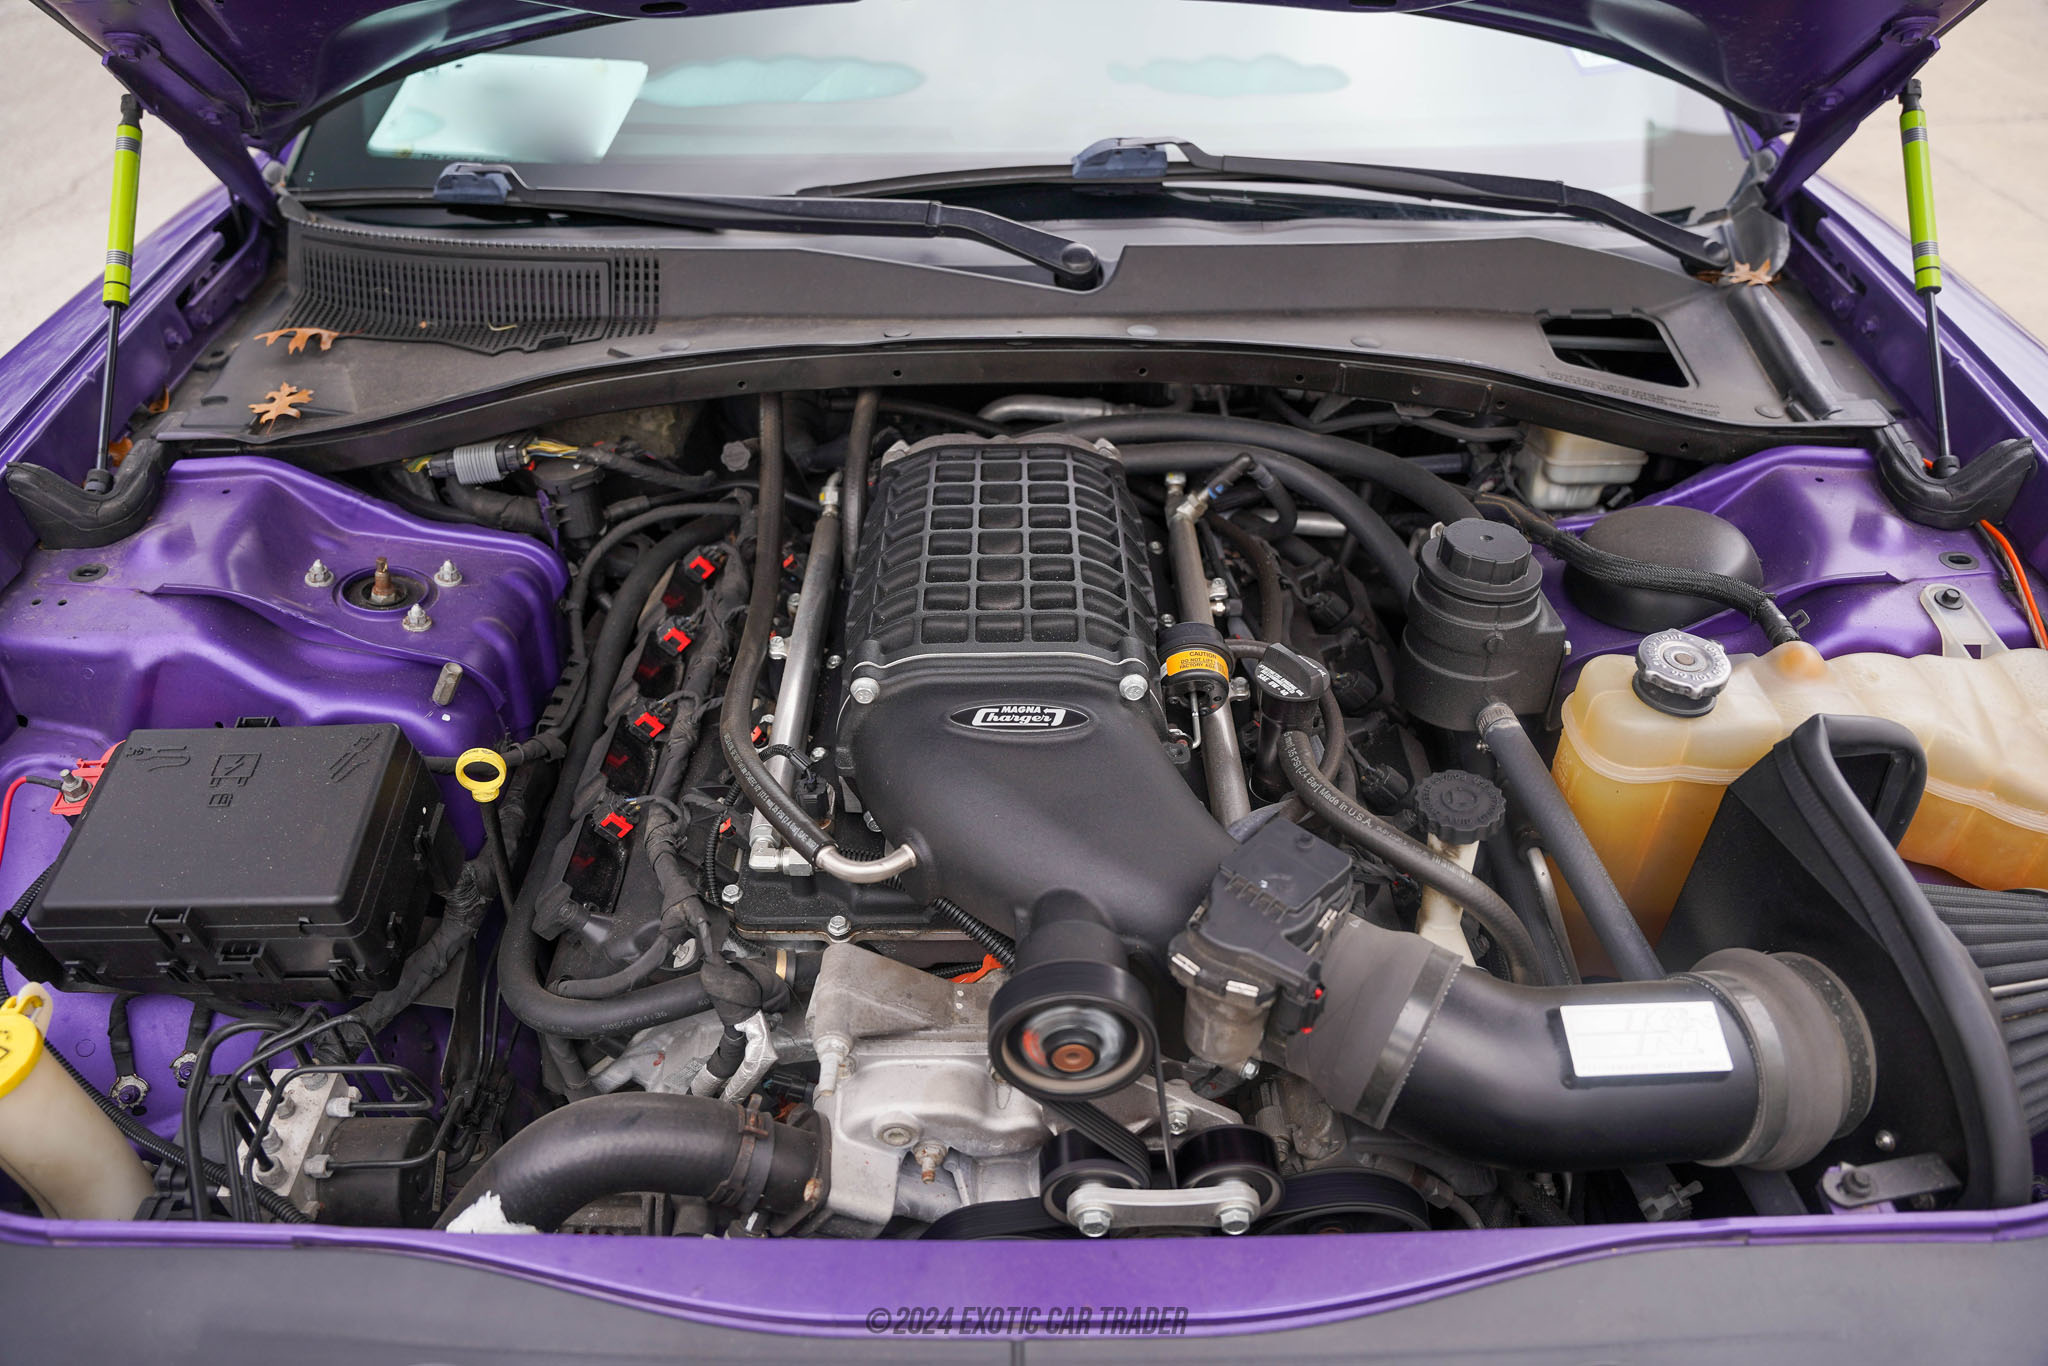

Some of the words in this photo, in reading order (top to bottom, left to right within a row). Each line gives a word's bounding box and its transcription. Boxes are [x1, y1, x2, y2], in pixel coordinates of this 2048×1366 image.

[1189, 651, 1217, 660] CAUTION
[1257, 673, 1270, 682] SAE
[1000, 705, 1041, 714] MAGNA
[971, 707, 1066, 727] Charger
[1287, 747, 1298, 758] 35
[1291, 755, 1303, 768] PSI
[1306, 775, 1321, 793] Bar]
[1319, 786, 1340, 806] Made
[1339, 801, 1348, 812] in
